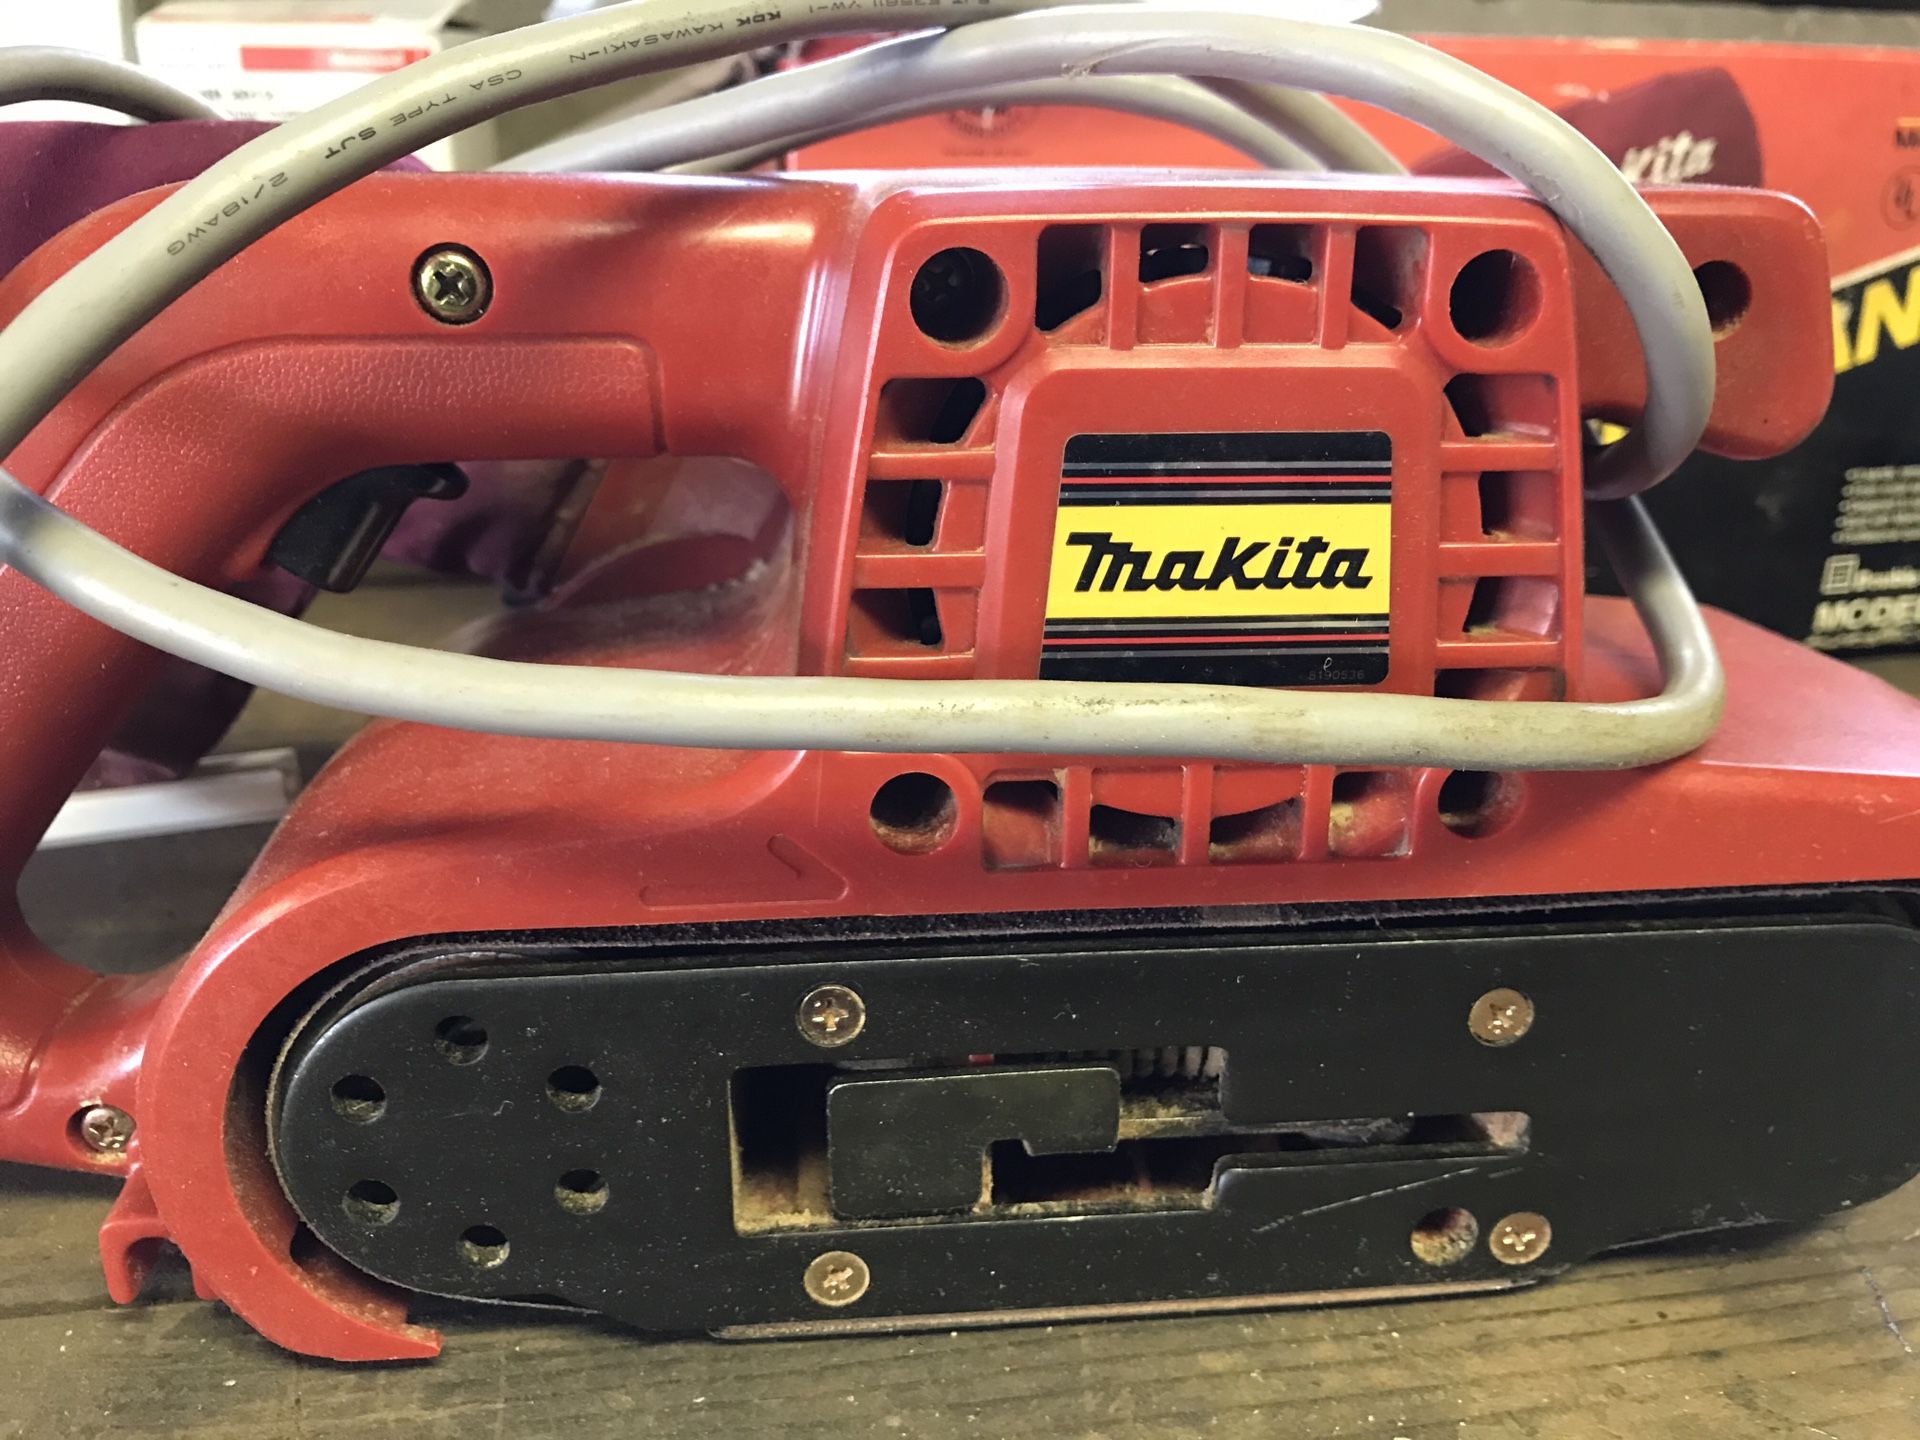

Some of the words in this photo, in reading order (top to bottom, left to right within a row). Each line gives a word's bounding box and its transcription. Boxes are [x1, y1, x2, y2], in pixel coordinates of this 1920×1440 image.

[736, 10, 782, 26] KDK
[569, 22, 724, 63] KAWASAKI-N
[469, 69, 522, 91] CSA
[389, 93, 458, 127] TYPE
[324, 126, 377, 159] SJT
[166, 171, 289, 256] 2/18AWG
[1066, 532, 1373, 592] Makita
